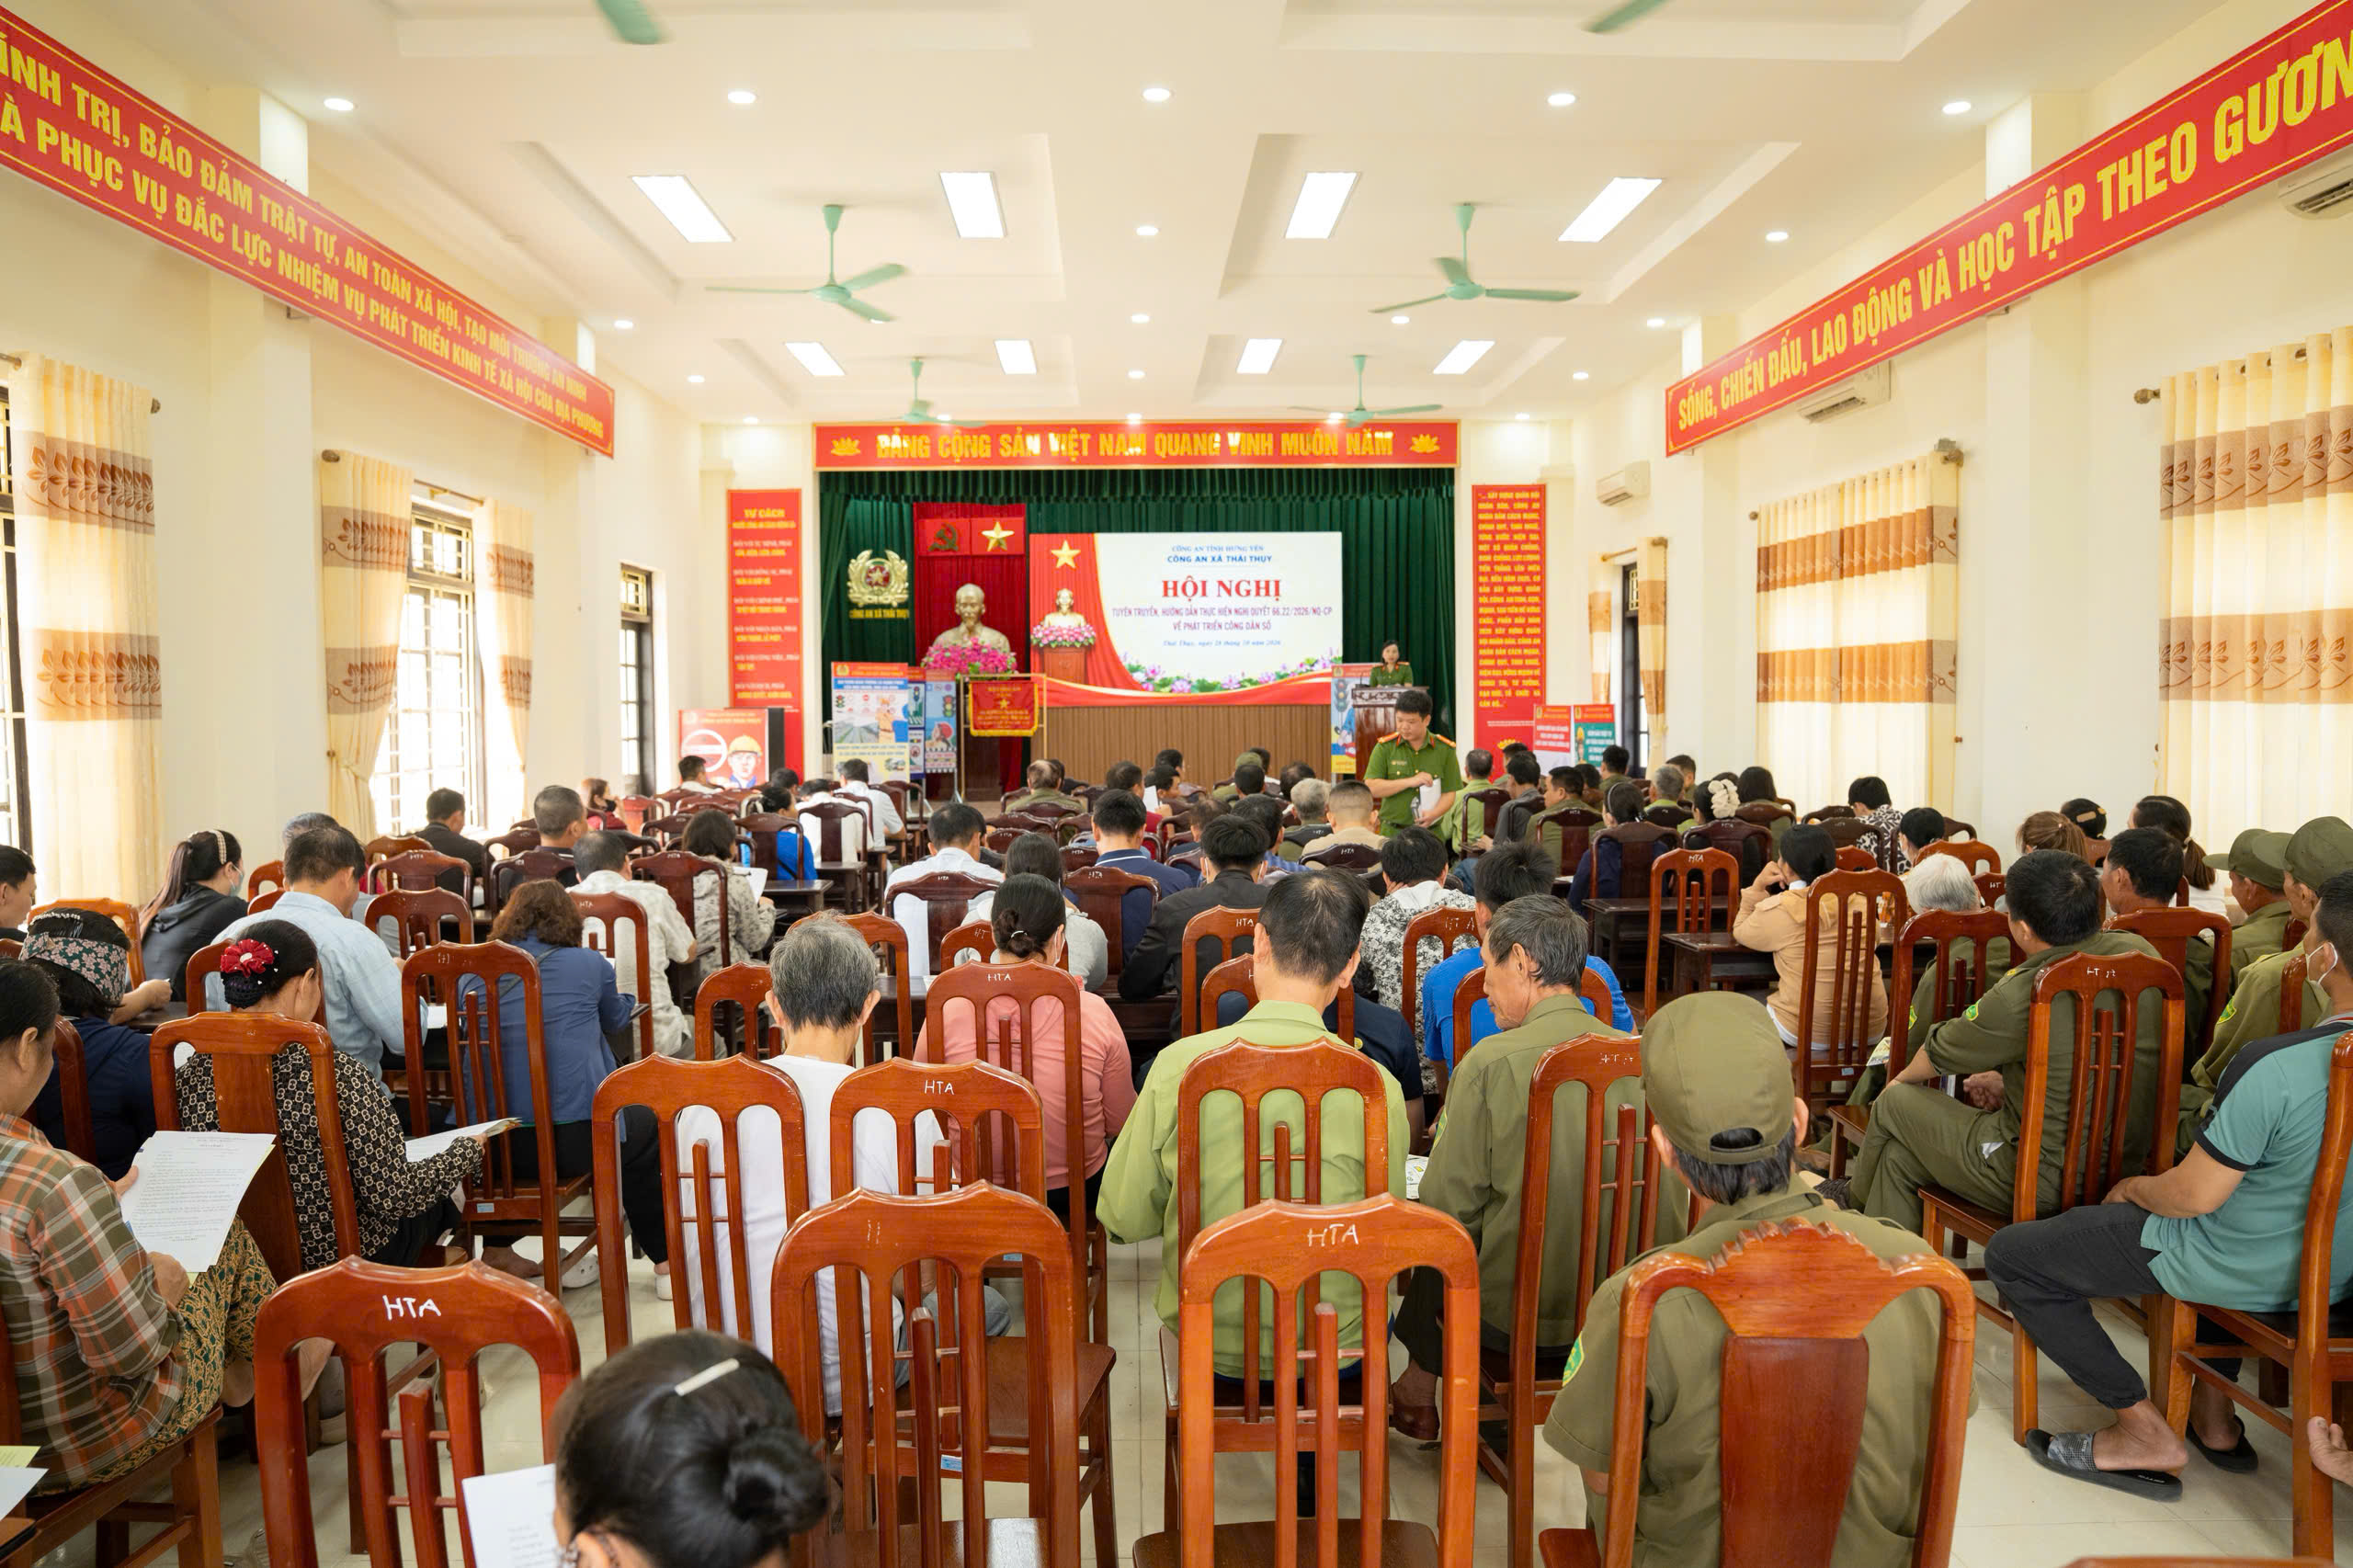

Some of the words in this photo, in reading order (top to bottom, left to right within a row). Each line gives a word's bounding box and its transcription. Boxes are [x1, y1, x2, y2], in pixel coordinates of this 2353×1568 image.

[72, 82, 130, 148] TRỊ,
[140, 124, 192, 178] BẢO
[200, 158, 253, 214] ĐẢM
[259, 193, 308, 244] TRẬT
[313, 225, 339, 266] TỰ,
[345, 245, 368, 279] AN
[372, 260, 411, 303] TOÀN
[415, 286, 433, 317] XÃ
[437, 299, 460, 335] HỘI,
[464, 315, 485, 346] TẠO
[37, 118, 123, 191] PHỤC
[132, 169, 167, 221] VỤ
[176, 193, 224, 244] ĐẮC
[232, 223, 272, 268] LỰC
[278, 248, 338, 303] NHIỆM
[344, 284, 365, 321] VỤ
[369, 298, 407, 338] PHÁT
[411, 320, 449, 360] TRIỂN
[452, 342, 481, 376] KINH
[1678, 381, 1717, 431] SỐNG,
[1720, 350, 1765, 410] CHIẾN
[1768, 329, 1808, 388] ĐẤU,
[1811, 313, 1847, 366] LAO
[1852, 278, 1913, 346] ĐỘNG
[1918, 248, 1952, 312] VÀ
[1958, 221, 2015, 292] HỌC
[2023, 184, 2086, 260] TẬP
[2097, 121, 2197, 222] THEO
[876, 426, 930, 459] ĐẢNG
[938, 429, 992, 462] CỘNG
[999, 426, 1040, 458] SẢN
[1048, 427, 1091, 461] VIỆT
[1098, 433, 1147, 457] NAM
[1154, 432, 1221, 459] QUANG
[1227, 432, 1273, 457] VINH
[1281, 427, 1338, 457] MUÔN
[1346, 428, 1393, 457] NĂM
[1167, 554, 1192, 563] CÔNG
[1226, 554, 1246, 562] THÁI
[1162, 574, 1209, 602] HỘI
[1216, 579, 1281, 602] NGHỊ
[1688, 854, 1704, 863] HTA
[1235, 917, 1254, 927] HTA
[986, 972, 1012, 983] HTA
[924, 1079, 955, 1096] HTA
[1306, 1222, 1359, 1249] HTA
[382, 1294, 441, 1321] HTA
